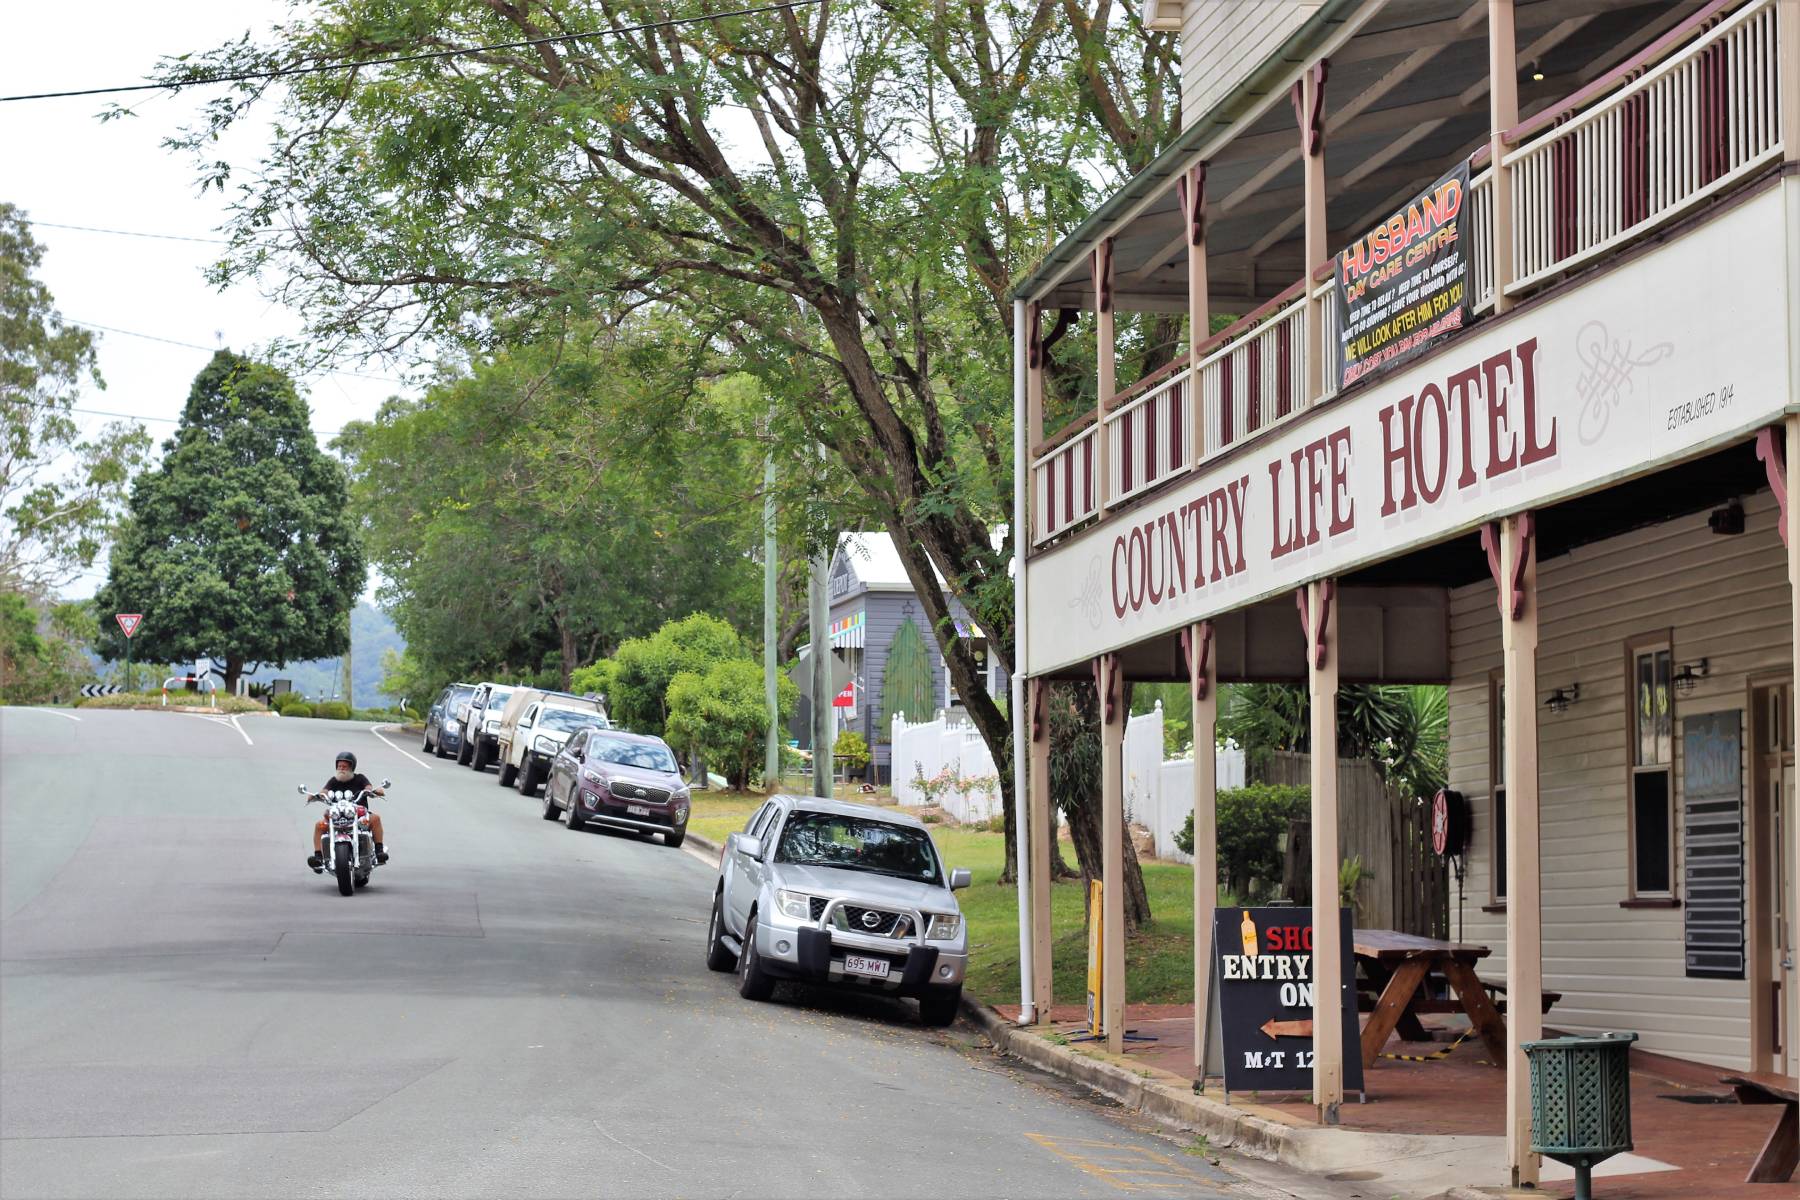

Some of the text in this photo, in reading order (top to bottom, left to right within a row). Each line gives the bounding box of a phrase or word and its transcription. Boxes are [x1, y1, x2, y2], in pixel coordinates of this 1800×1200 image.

[1343, 179, 1462, 284] HUSBAND
[1347, 221, 1458, 302] DAY CARE CENTRE
[1341, 327, 1353, 341] WANT
[1354, 324, 1358, 334] TO
[1359, 320, 1365, 331] GO
[1391, 297, 1405, 312] LEAVE
[1406, 289, 1418, 304] YOUR
[1420, 276, 1444, 296] HUSBAND
[1446, 268, 1457, 282] WITH
[1349, 309, 1359, 323] NEED
[1360, 303, 1371, 317] TIME
[1371, 300, 1376, 310] TO
[1398, 279, 1409, 295] NEED
[1411, 272, 1421, 288] TIME
[1423, 268, 1429, 281] TO
[1430, 253, 1458, 275] YOURSELF?
[1345, 342, 1356, 361] WE
[1357, 334, 1371, 355] WILL
[1372, 323, 1390, 346] LOOK
[1392, 310, 1415, 335] AFTER
[1417, 302, 1432, 323] HIM
[1433, 291, 1448, 314] FOR
[1668, 383, 1734, 430] ESTABLISHED 1914
[1111, 336, 1557, 620] COUNTRY LIFE HOTEL
[848, 959, 886, 973] 695 MWI
[1222, 954, 1310, 980] ENTRY
[1265, 926, 1313, 950] SHO
[1280, 982, 1314, 1007] ON
